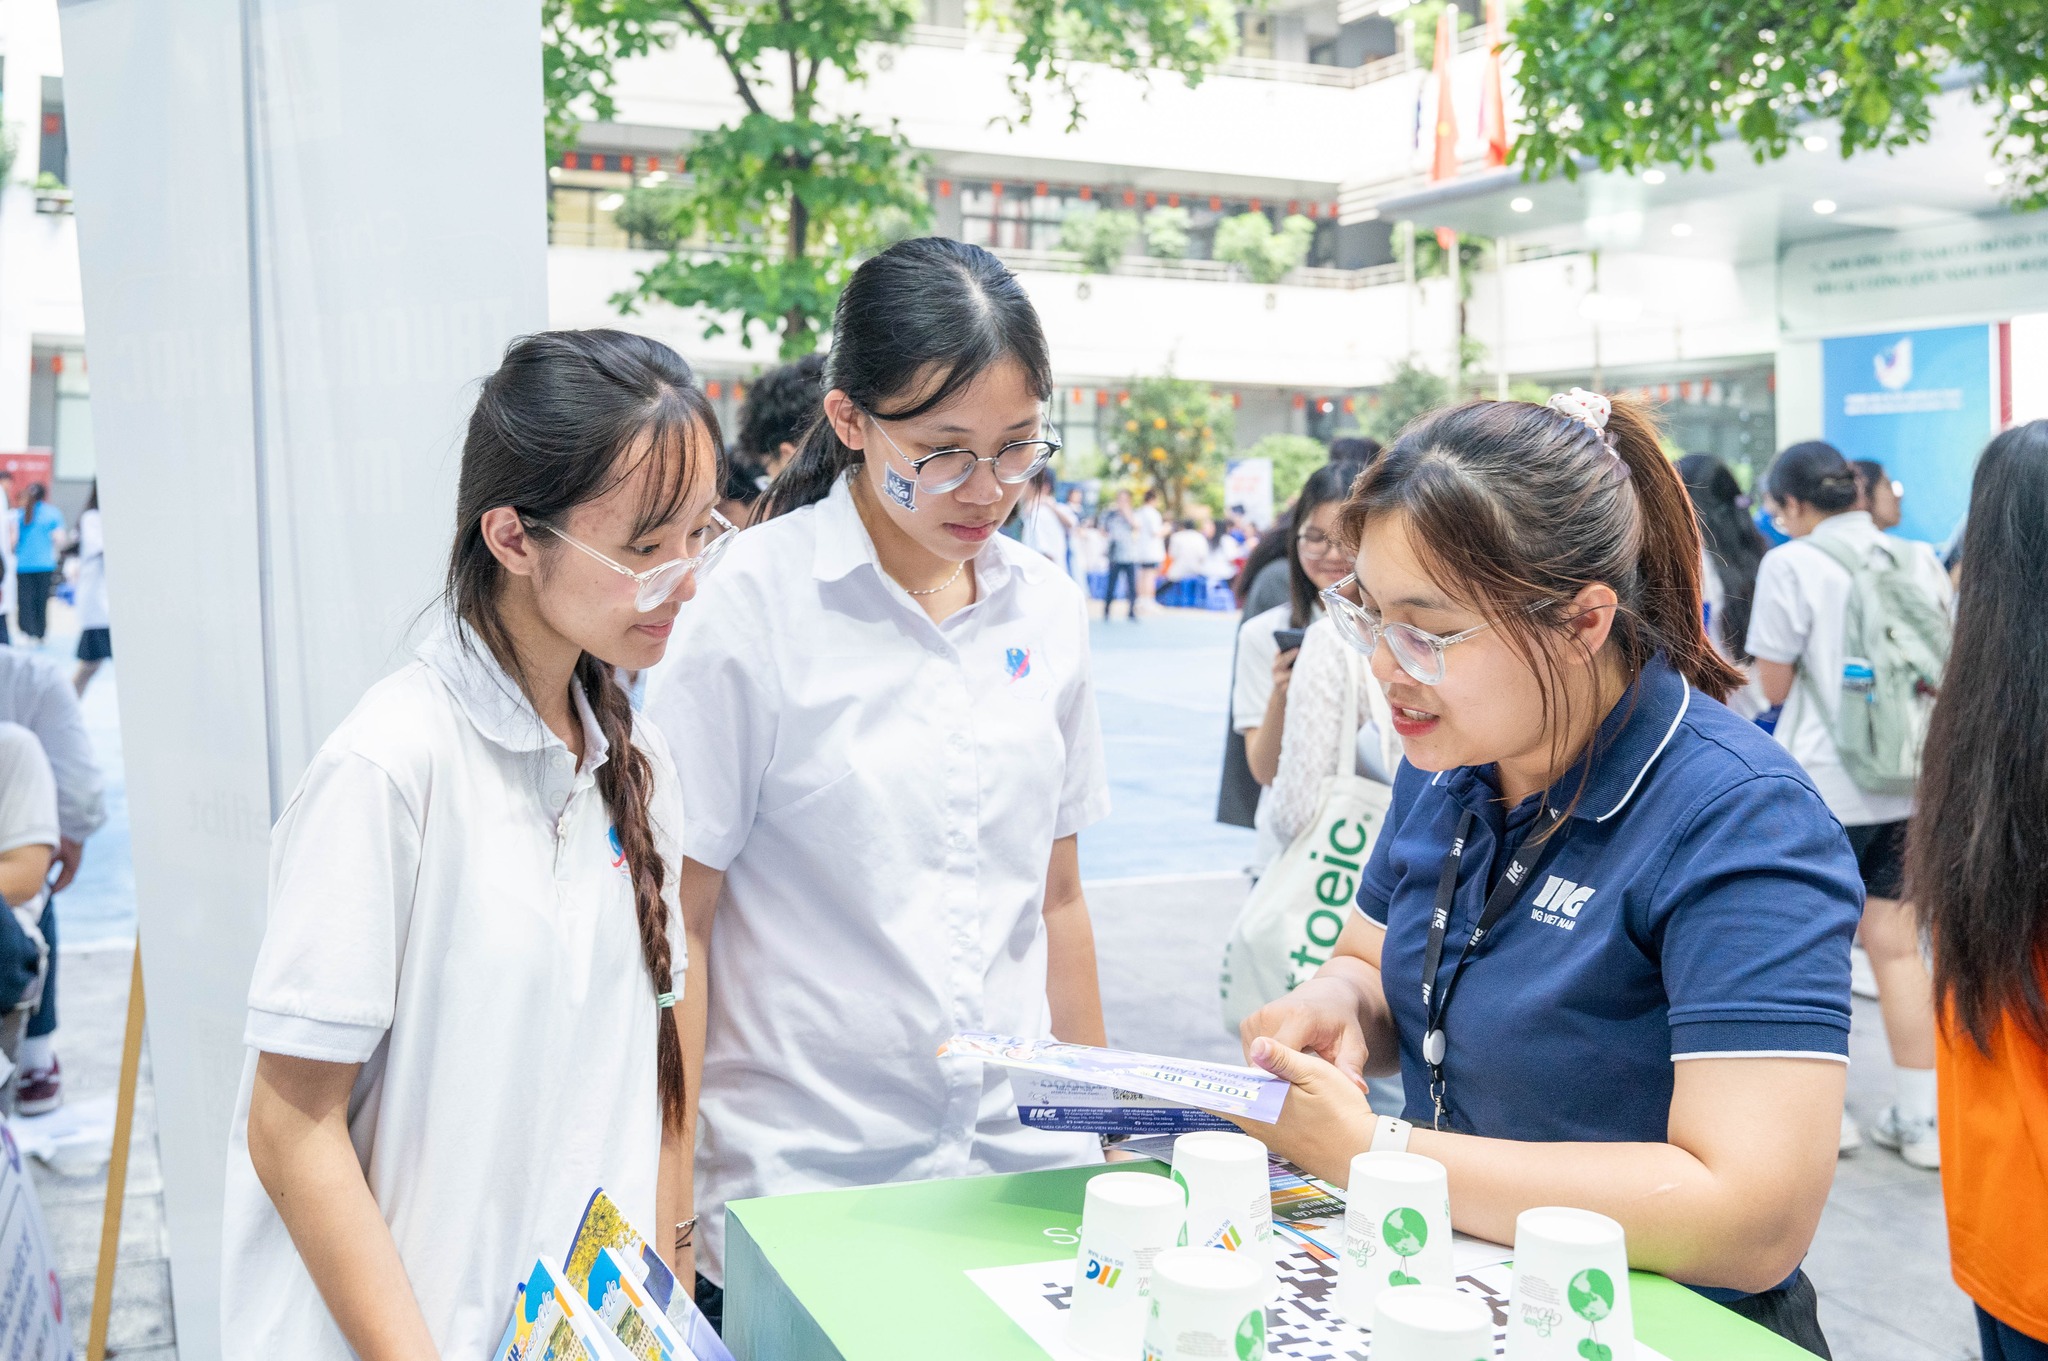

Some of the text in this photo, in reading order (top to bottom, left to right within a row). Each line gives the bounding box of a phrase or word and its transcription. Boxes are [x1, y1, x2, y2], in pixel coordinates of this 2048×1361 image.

[1505, 860, 1524, 884] IIG
[1532, 875, 1596, 918] IIG
[1543, 911, 1560, 926] VIET
[1557, 915, 1576, 931] NAM
[1194, 1079, 1252, 1099] TOEFL
[1029, 1108, 1057, 1118] IIG
[1085, 1258, 1122, 1289] IIG
